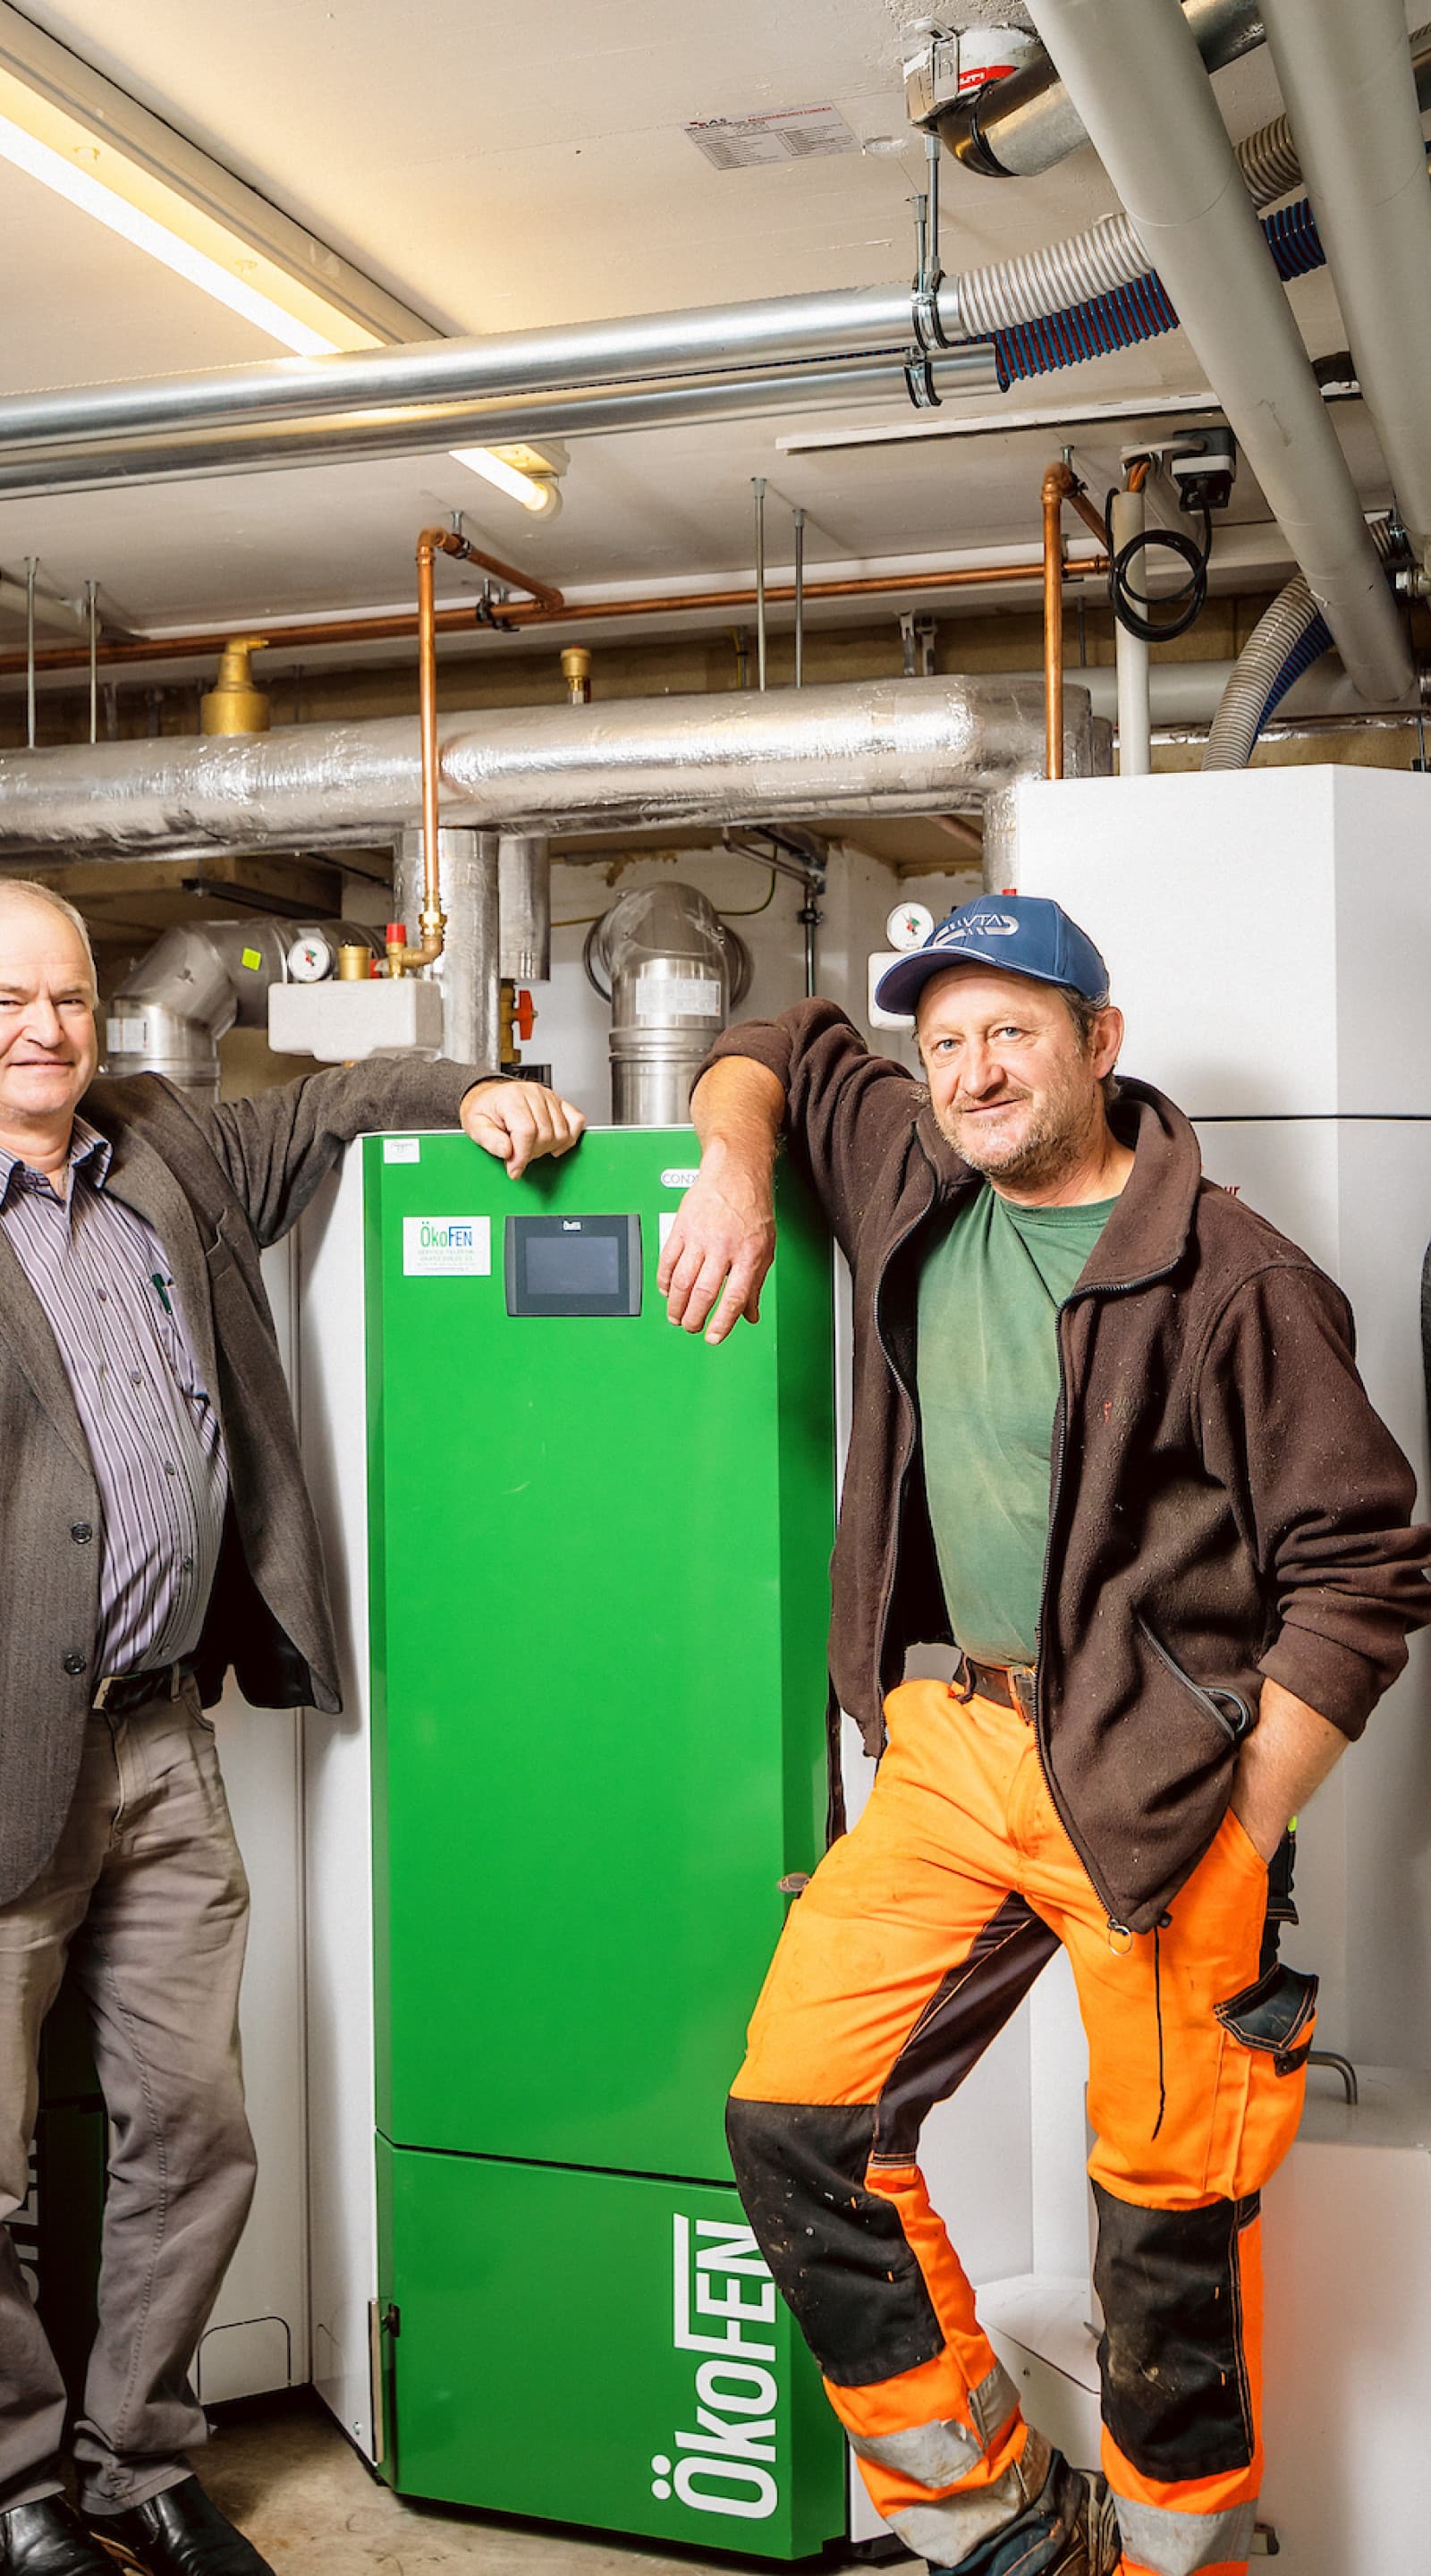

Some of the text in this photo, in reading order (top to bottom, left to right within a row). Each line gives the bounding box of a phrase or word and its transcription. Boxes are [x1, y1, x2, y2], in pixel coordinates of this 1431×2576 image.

[663, 1173, 699, 1185] COND
[420, 1221, 473, 1248] ÖkoFEN
[651, 2213, 777, 2519] ÖkoFEN
